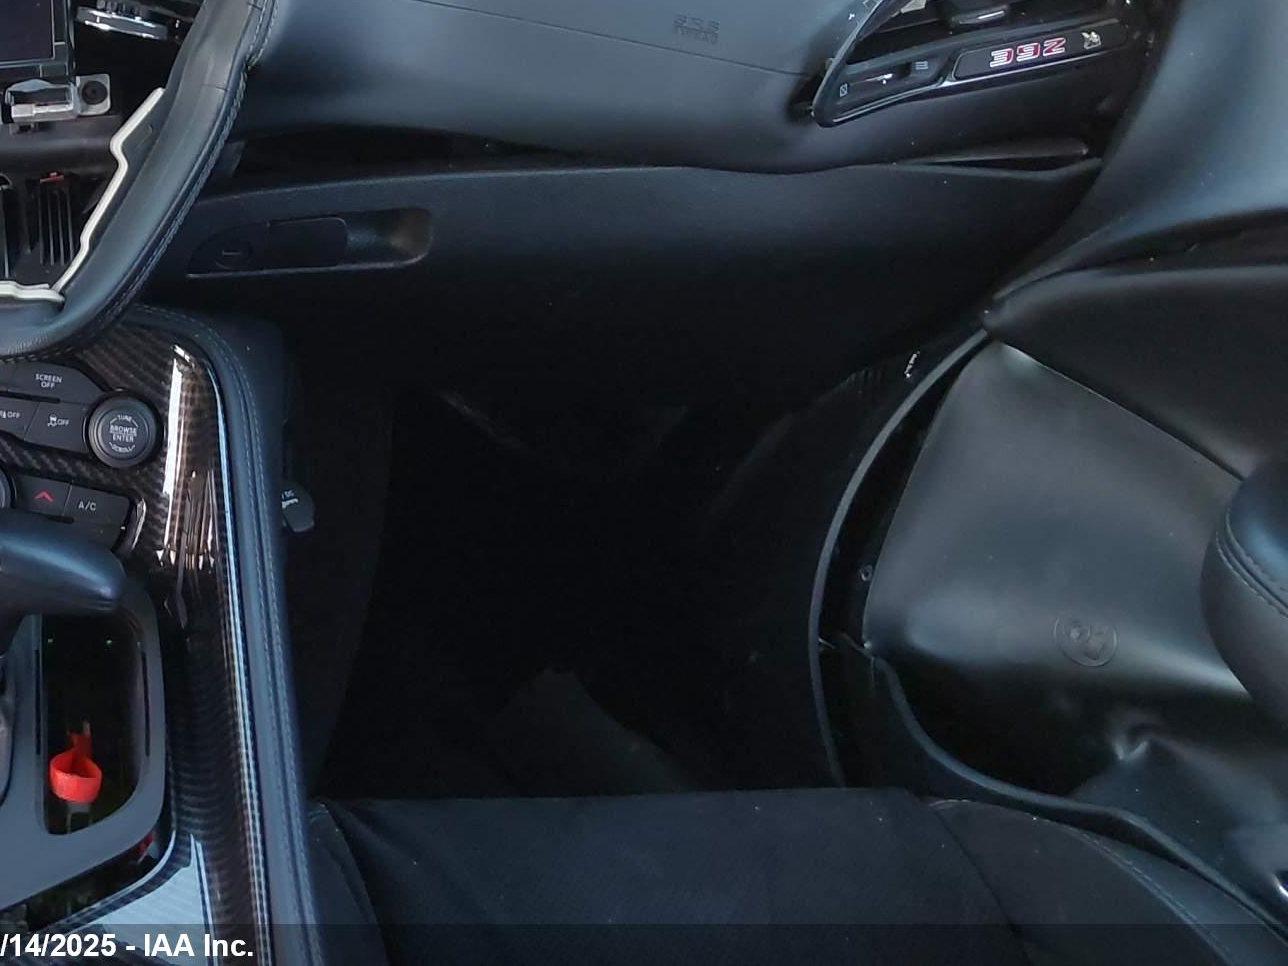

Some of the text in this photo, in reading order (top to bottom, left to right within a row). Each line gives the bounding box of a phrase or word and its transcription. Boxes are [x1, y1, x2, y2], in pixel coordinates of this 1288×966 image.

[989, 37, 1067, 68] 392
[35, 373, 62, 384] SCREEN
[40, 381, 55, 389] OFF
[7, 411, 21, 419] OFF
[109, 424, 137, 435] BROWSE
[112, 434, 134, 443] ENTER
[77, 500, 97, 511] A/C
